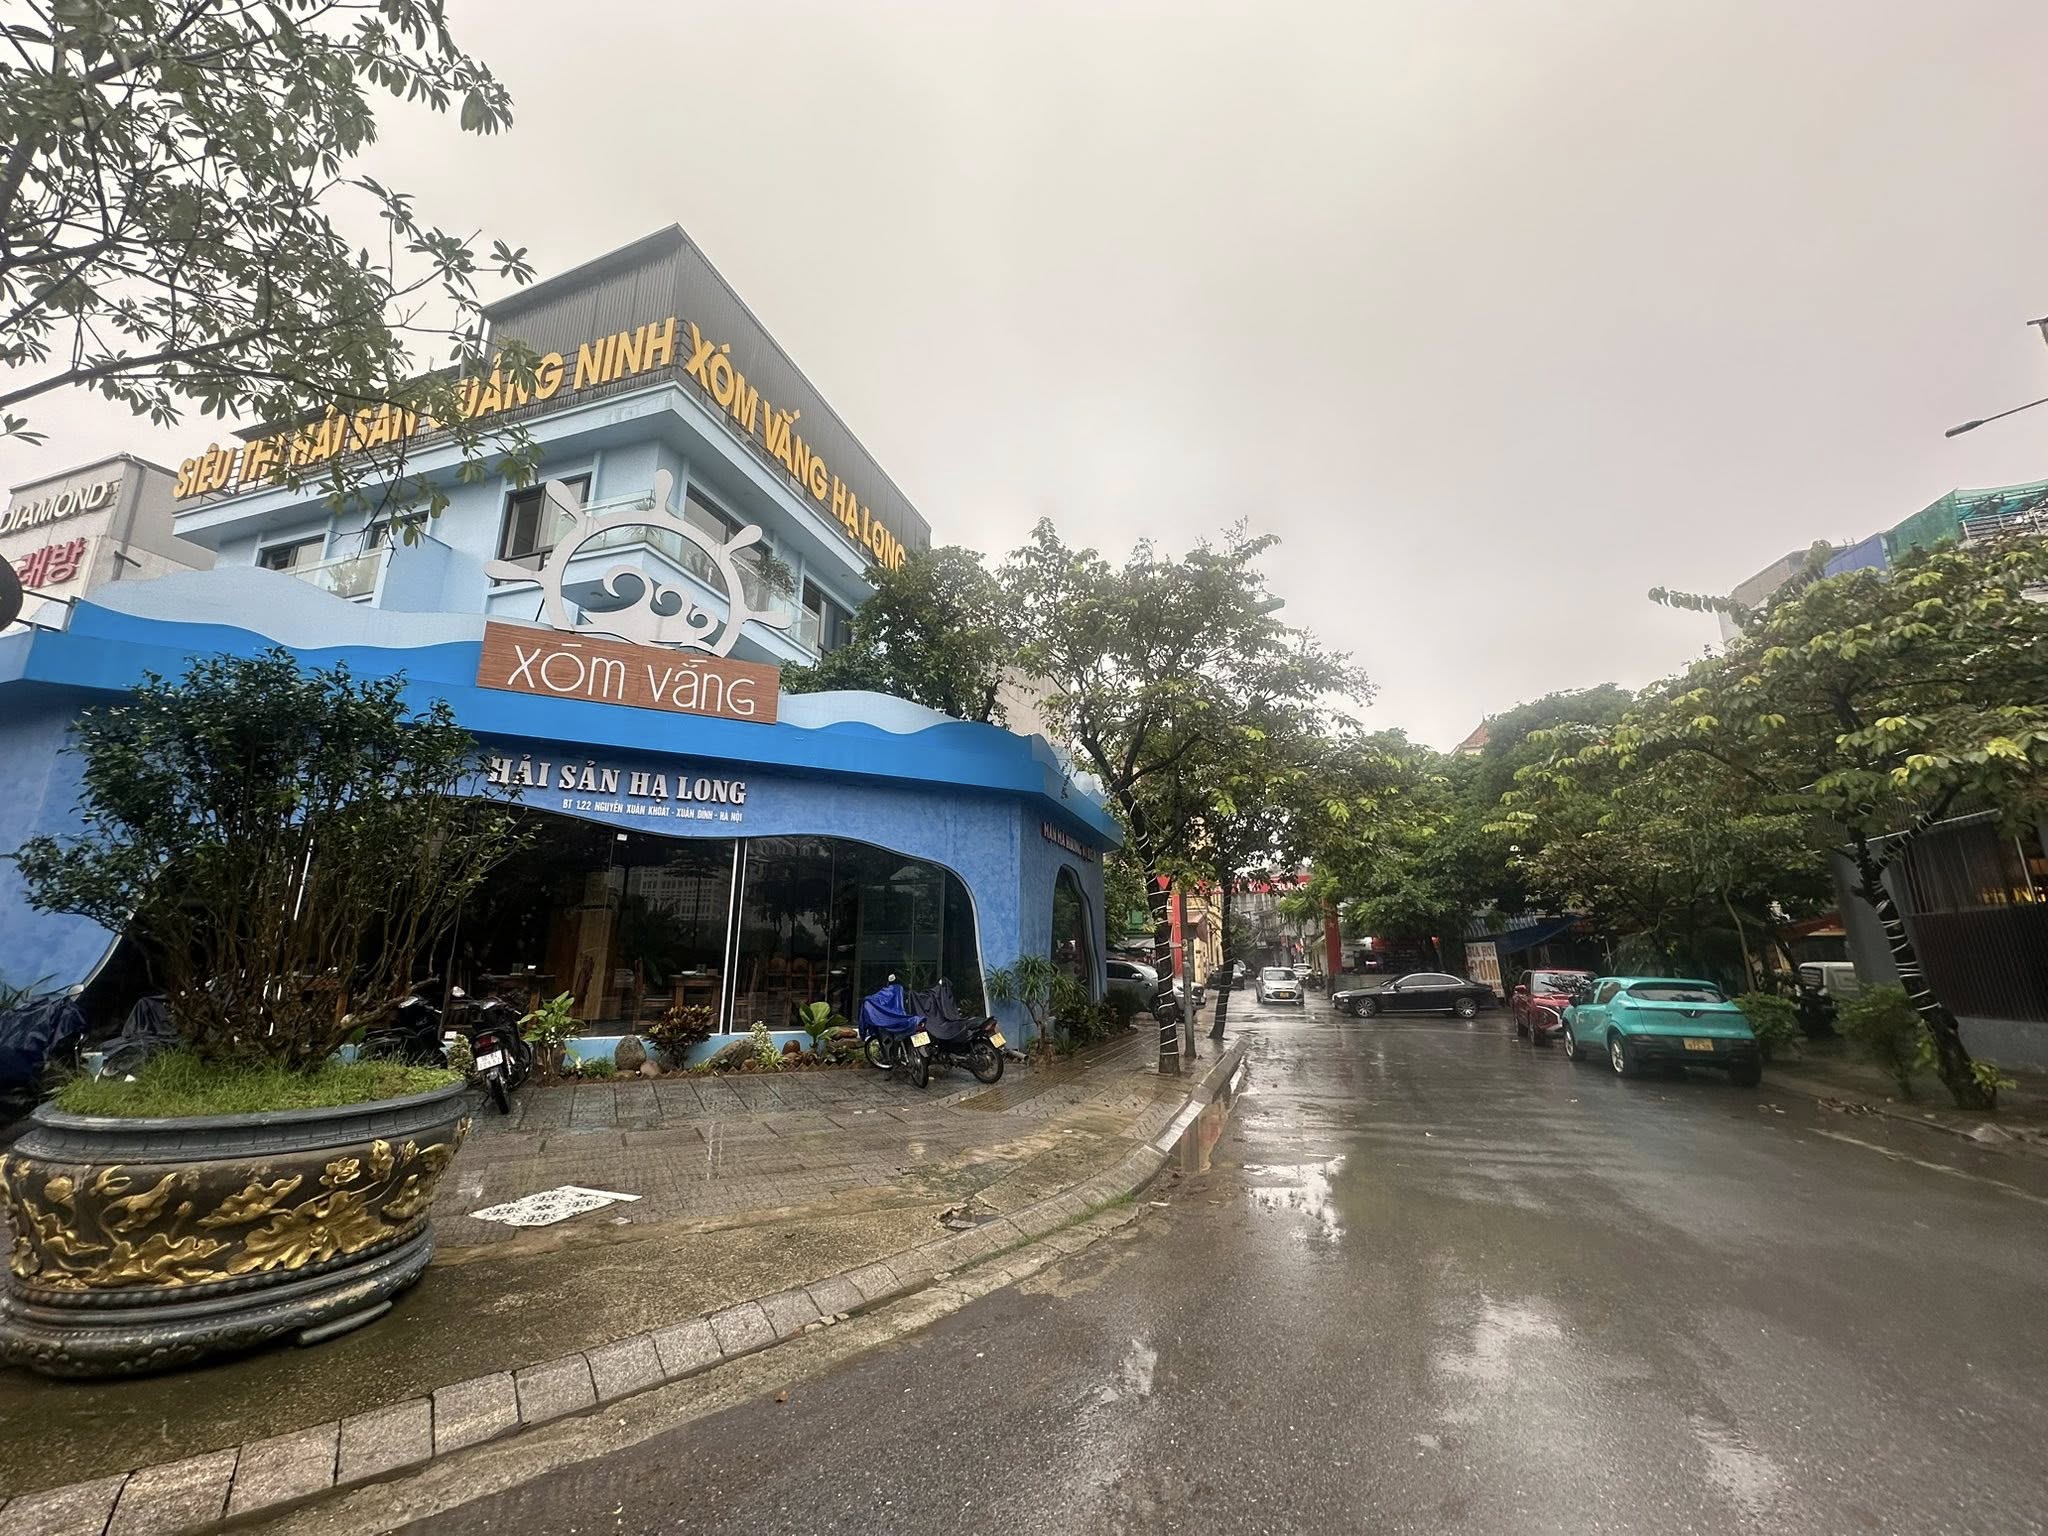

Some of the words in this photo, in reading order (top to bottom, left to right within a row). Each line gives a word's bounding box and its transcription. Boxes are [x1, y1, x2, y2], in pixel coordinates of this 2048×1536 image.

[173, 442, 237, 499] SIÊU
[573, 316, 679, 391] NINH
[684, 321, 759, 434] XÓM
[763, 401, 828, 500] VẮNG
[831, 475, 860, 539] HẠ
[0, 482, 107, 533] DIAMOND
[487, 753, 552, 788] HẢI
[558, 760, 621, 793] SẢN
[629, 771, 669, 803] HẠ
[676, 776, 747, 805] LONG
[562, 798, 573, 810] BT
